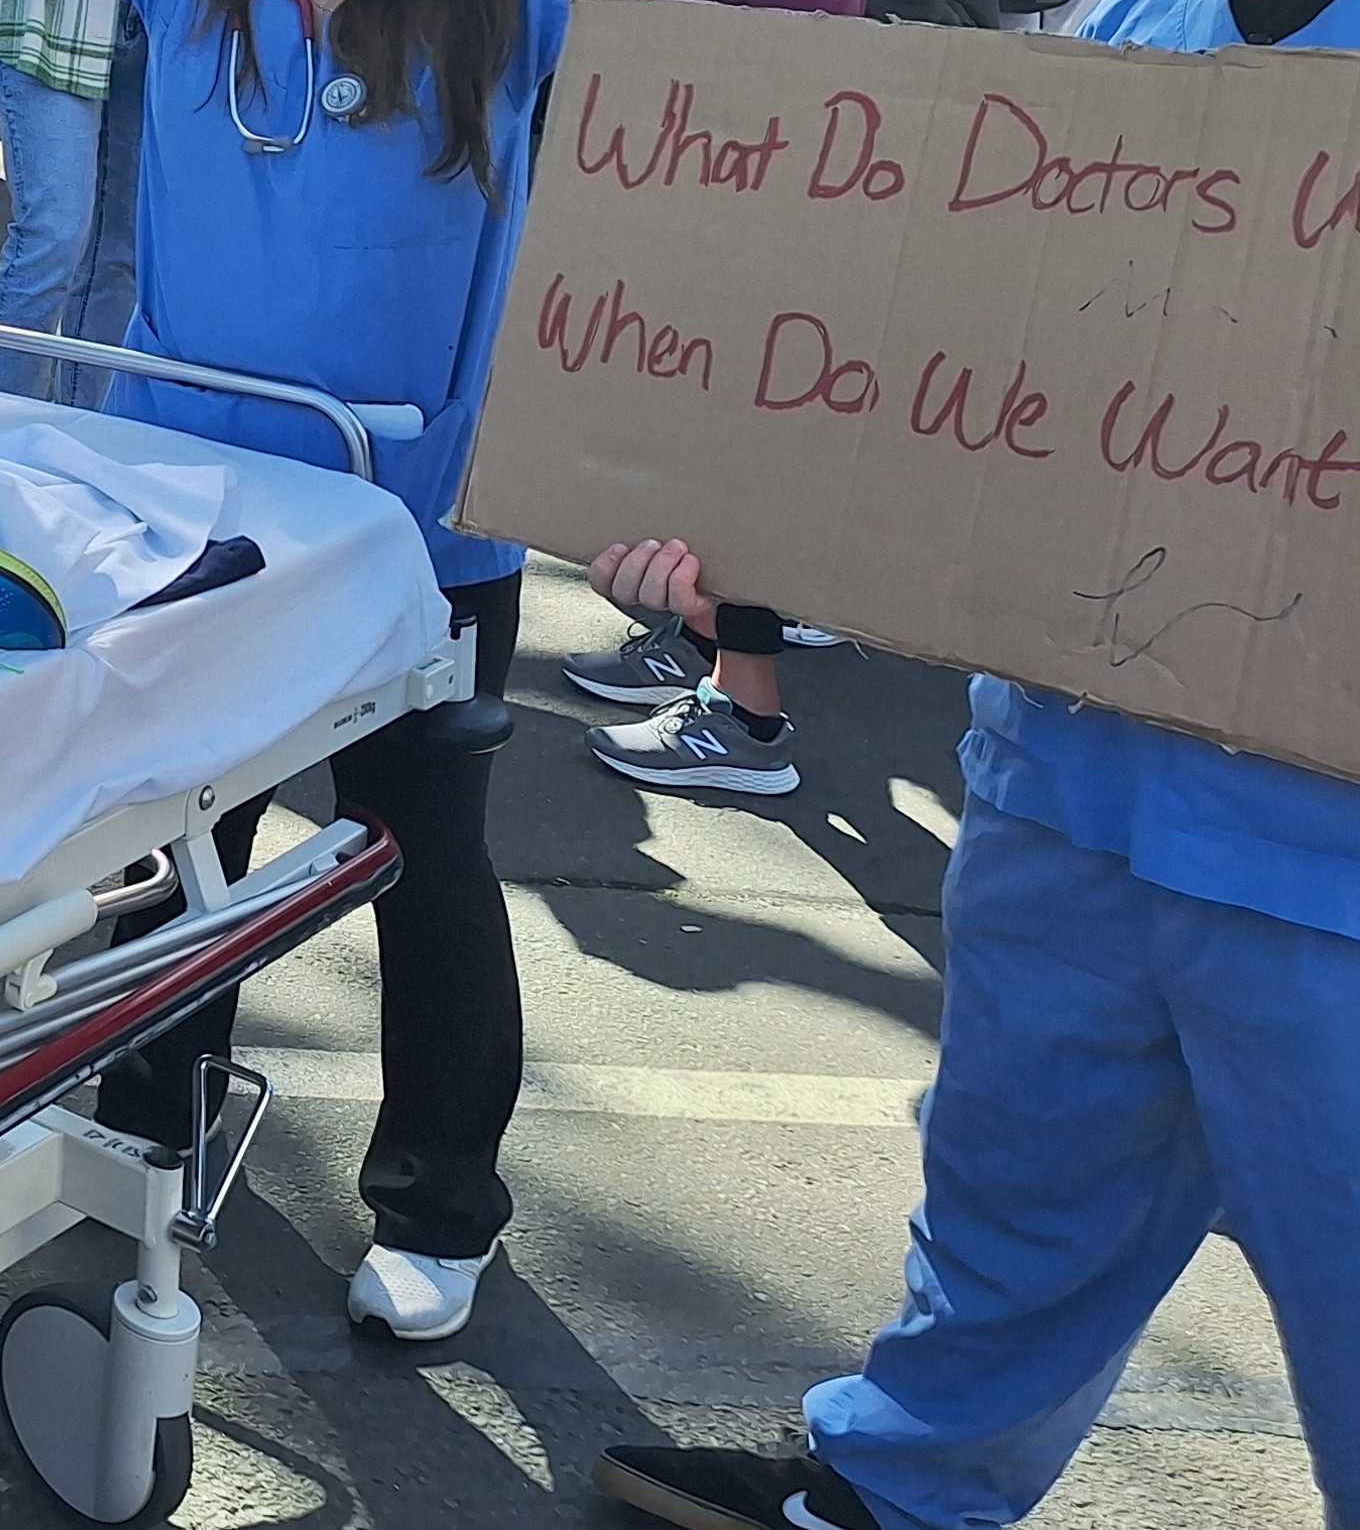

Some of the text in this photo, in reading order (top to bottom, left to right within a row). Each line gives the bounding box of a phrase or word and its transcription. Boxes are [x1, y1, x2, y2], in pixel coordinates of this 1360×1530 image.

[575, 72, 790, 191] What
[807, 90, 905, 203] Do
[948, 93, 1242, 234] Doctors
[537, 273, 713, 391] When
[910, 351, 1056, 459] We
[1098, 380, 1360, 511] Want
